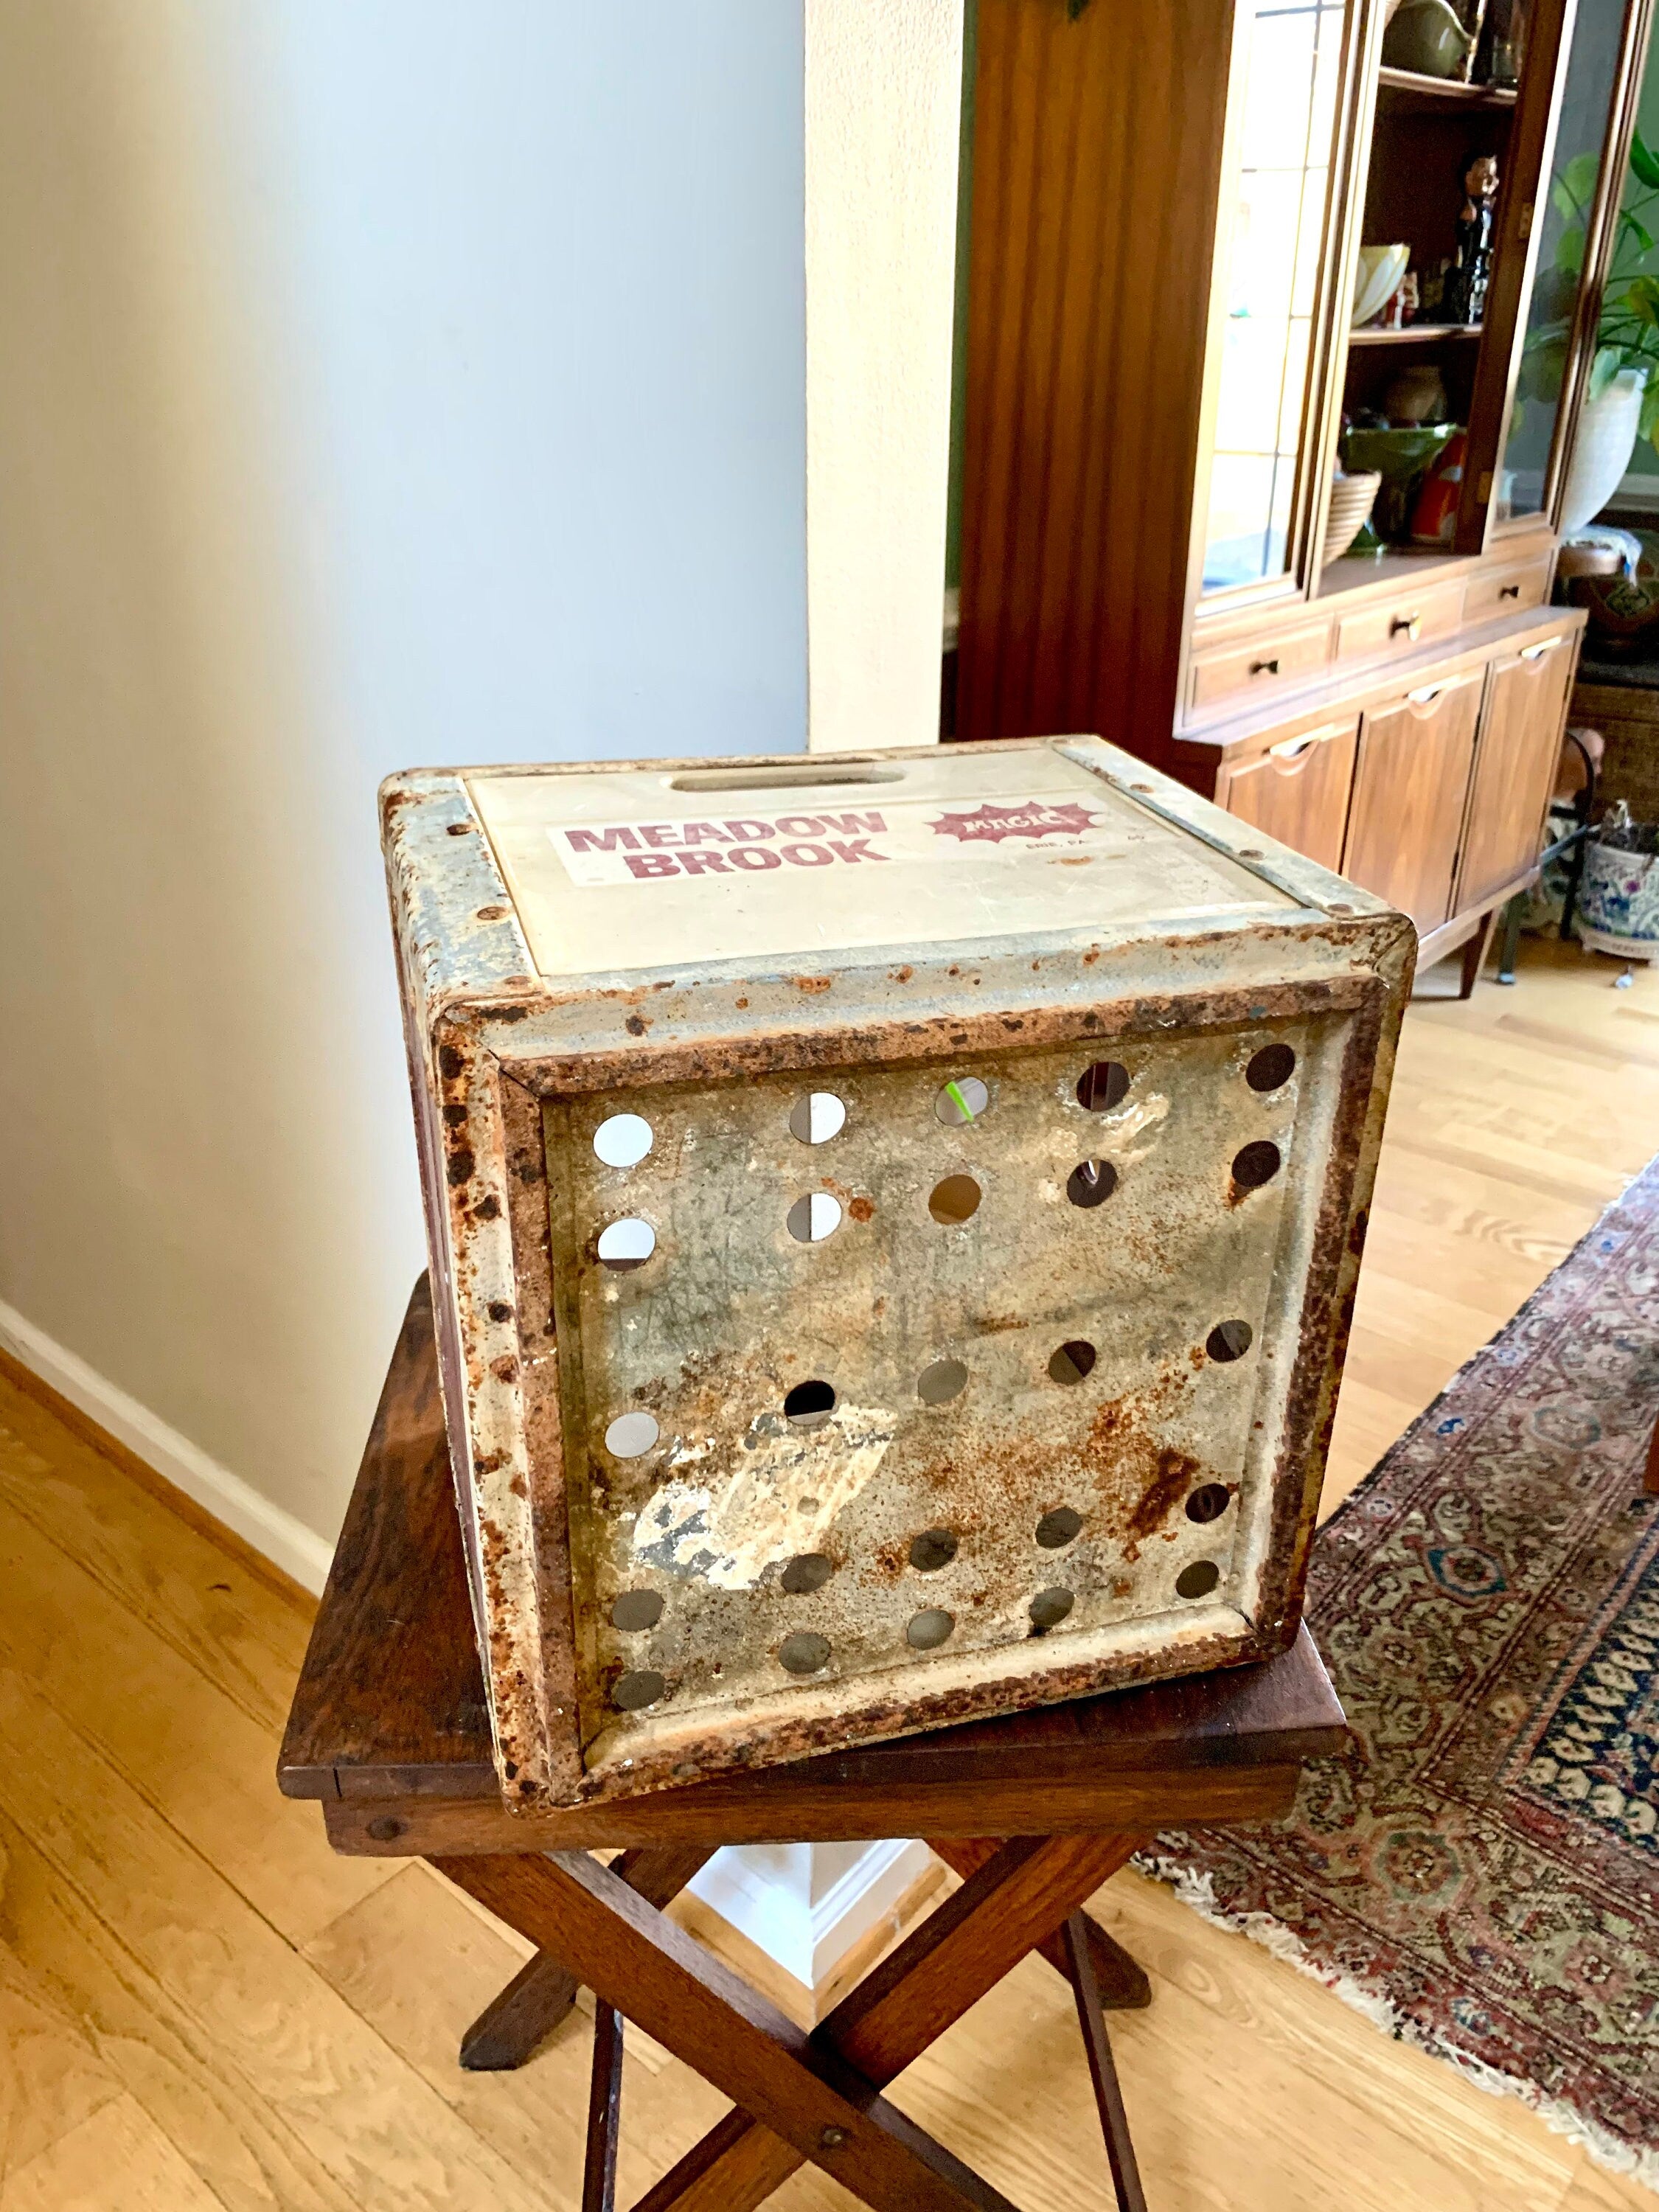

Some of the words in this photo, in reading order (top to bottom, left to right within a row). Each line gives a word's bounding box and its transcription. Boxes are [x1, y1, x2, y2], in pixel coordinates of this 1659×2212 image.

[564, 812, 888, 852] MEADOW
[962, 812, 1063, 832] MAGIC
[622, 838, 891, 879] BROOK
